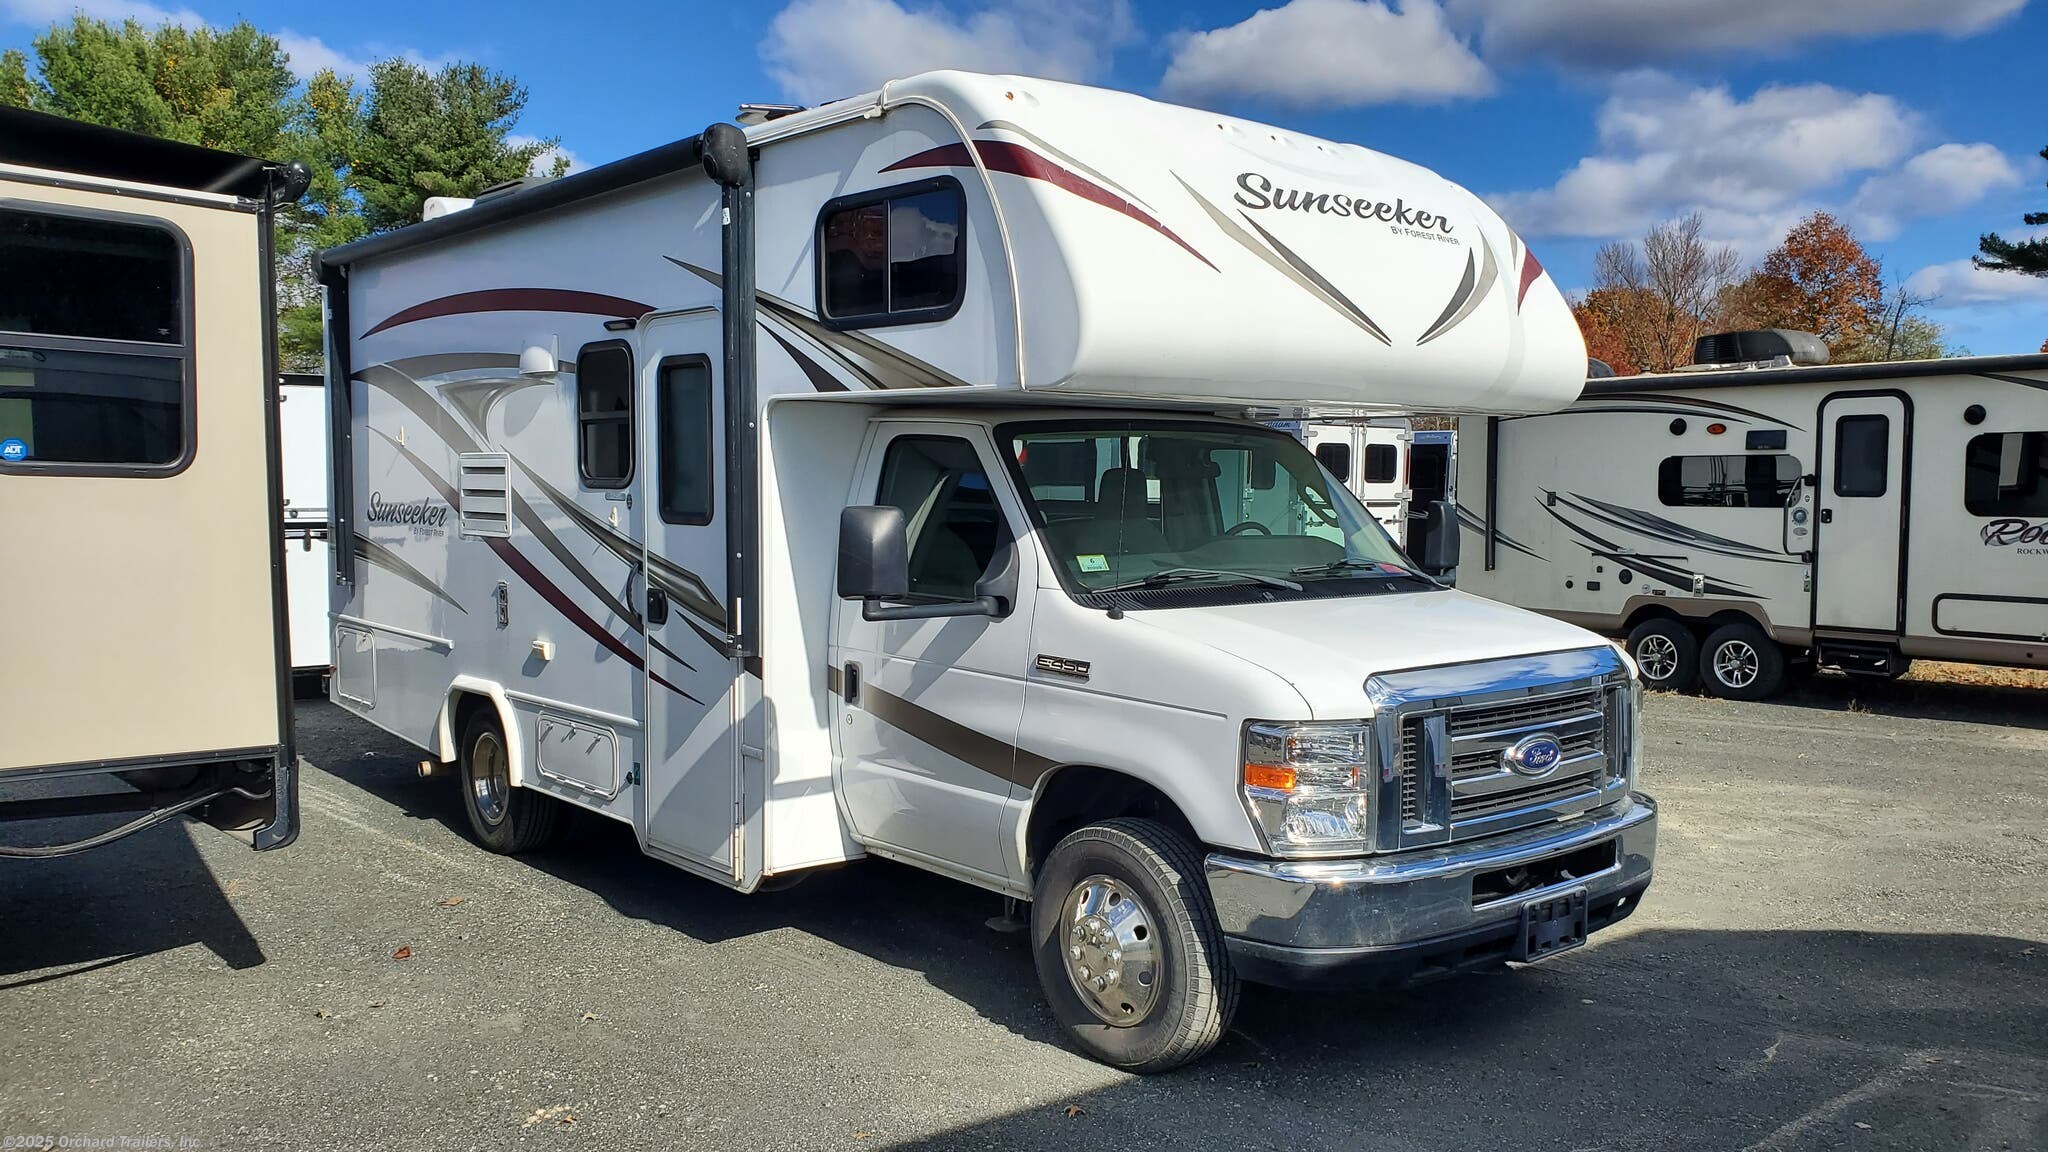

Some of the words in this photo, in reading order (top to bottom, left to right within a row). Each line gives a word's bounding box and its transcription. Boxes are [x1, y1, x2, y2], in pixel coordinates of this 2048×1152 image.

[1234, 172, 1454, 234] Sunseeker
[1391, 225, 1402, 235] BY
[1404, 228, 1436, 241] FOREST
[1437, 233, 1460, 246] RIVER
[4, 445, 23, 454] ADT
[367, 491, 447, 528] Sunseeker
[1529, 747, 1554, 765] Ford
